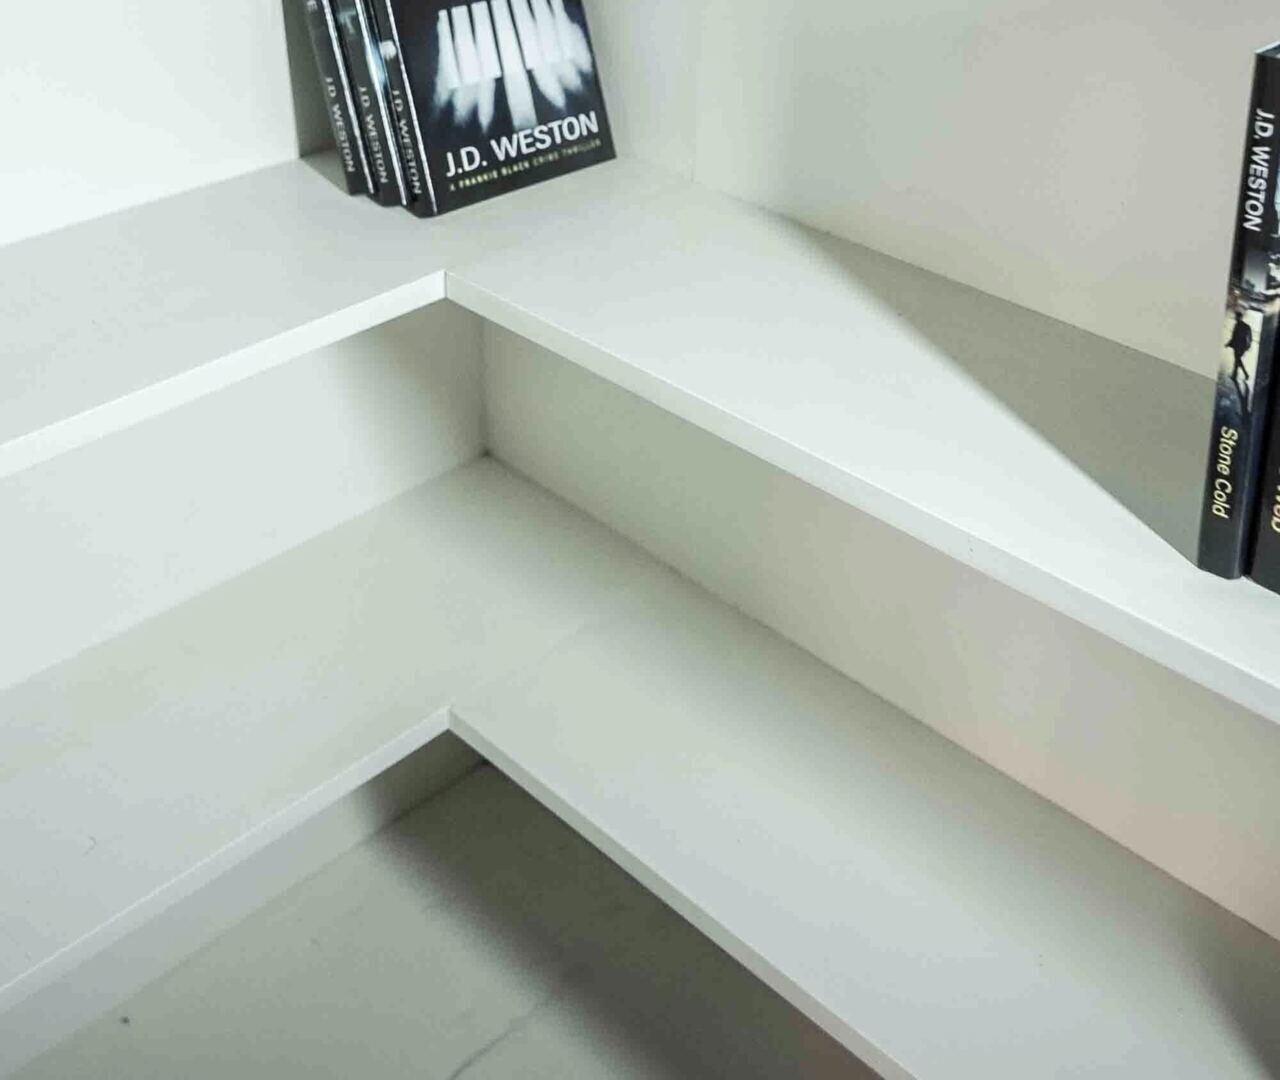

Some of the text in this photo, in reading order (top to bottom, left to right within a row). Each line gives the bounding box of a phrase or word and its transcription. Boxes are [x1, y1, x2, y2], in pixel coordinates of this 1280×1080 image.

[332, 103, 356, 172] WESTON
[365, 113, 389, 183] WESTON
[399, 119, 422, 194] WESTON
[445, 146, 488, 178] J.D.
[489, 110, 600, 162] WESTON
[1242, 107, 1276, 232] J.D. WESTON
[1211, 425, 1238, 520] Stone Cold
